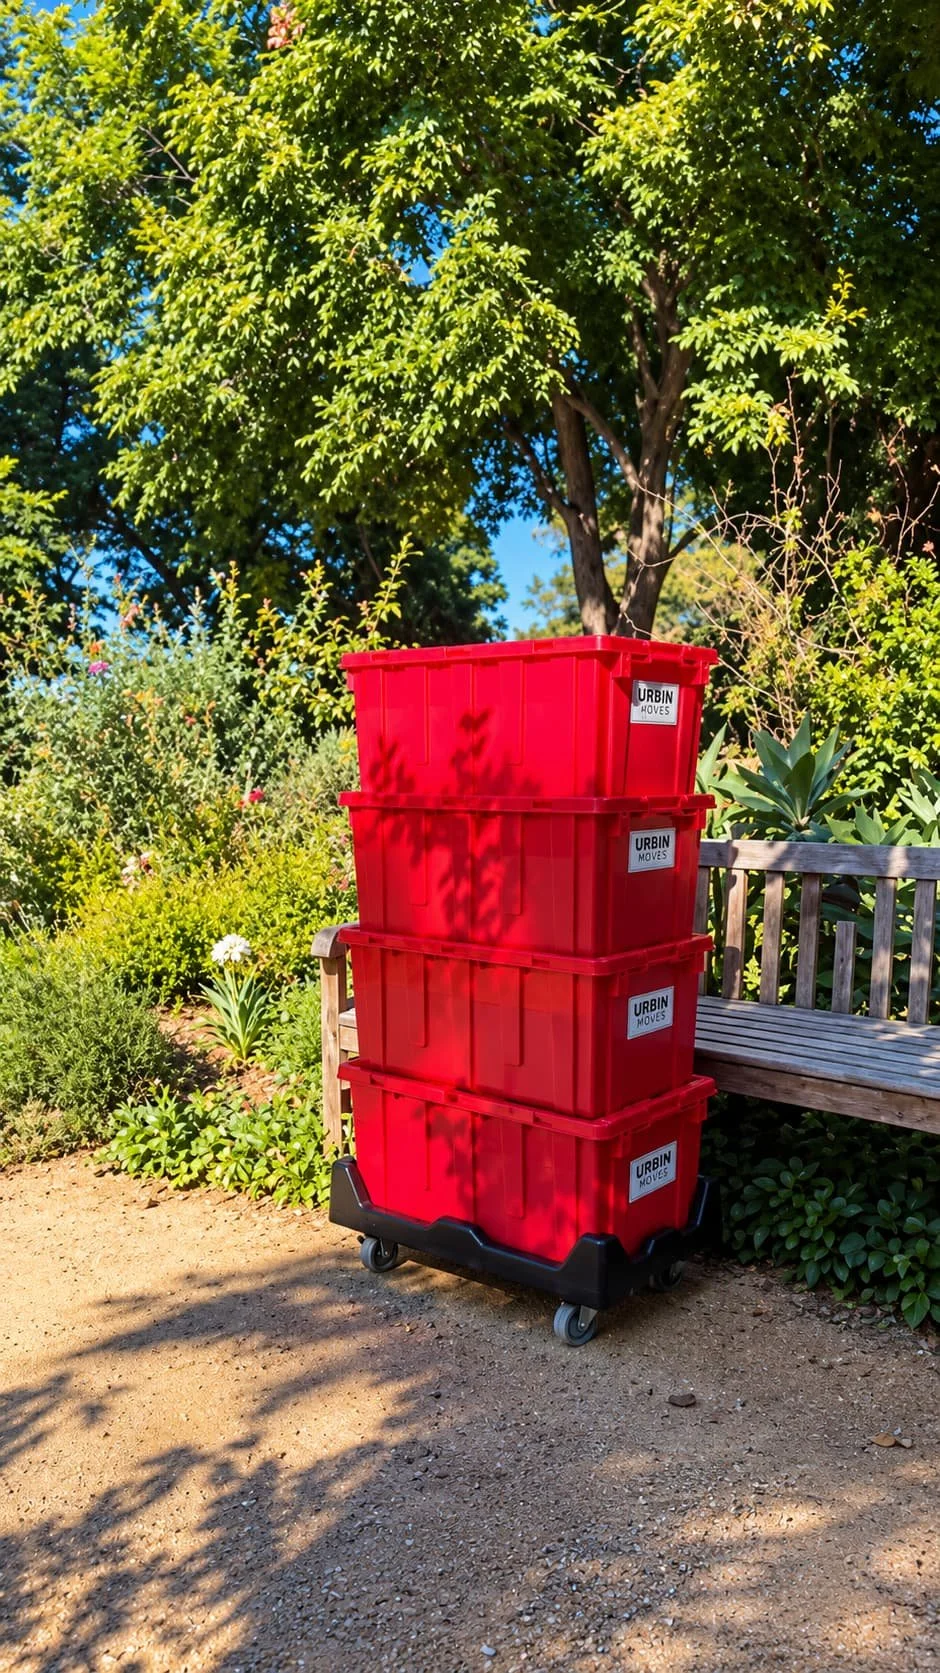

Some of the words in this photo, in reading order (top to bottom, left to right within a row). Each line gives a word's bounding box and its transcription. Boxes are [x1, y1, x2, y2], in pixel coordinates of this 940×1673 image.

[638, 688, 673, 704] URBIN
[635, 835, 670, 851] URBIN
[638, 850, 667, 862] MOVES
[634, 995, 668, 1017] URBIN
[637, 1011, 666, 1028] MOVES
[636, 1151, 671, 1178] URBIN
[639, 1168, 668, 1188] MOVES
